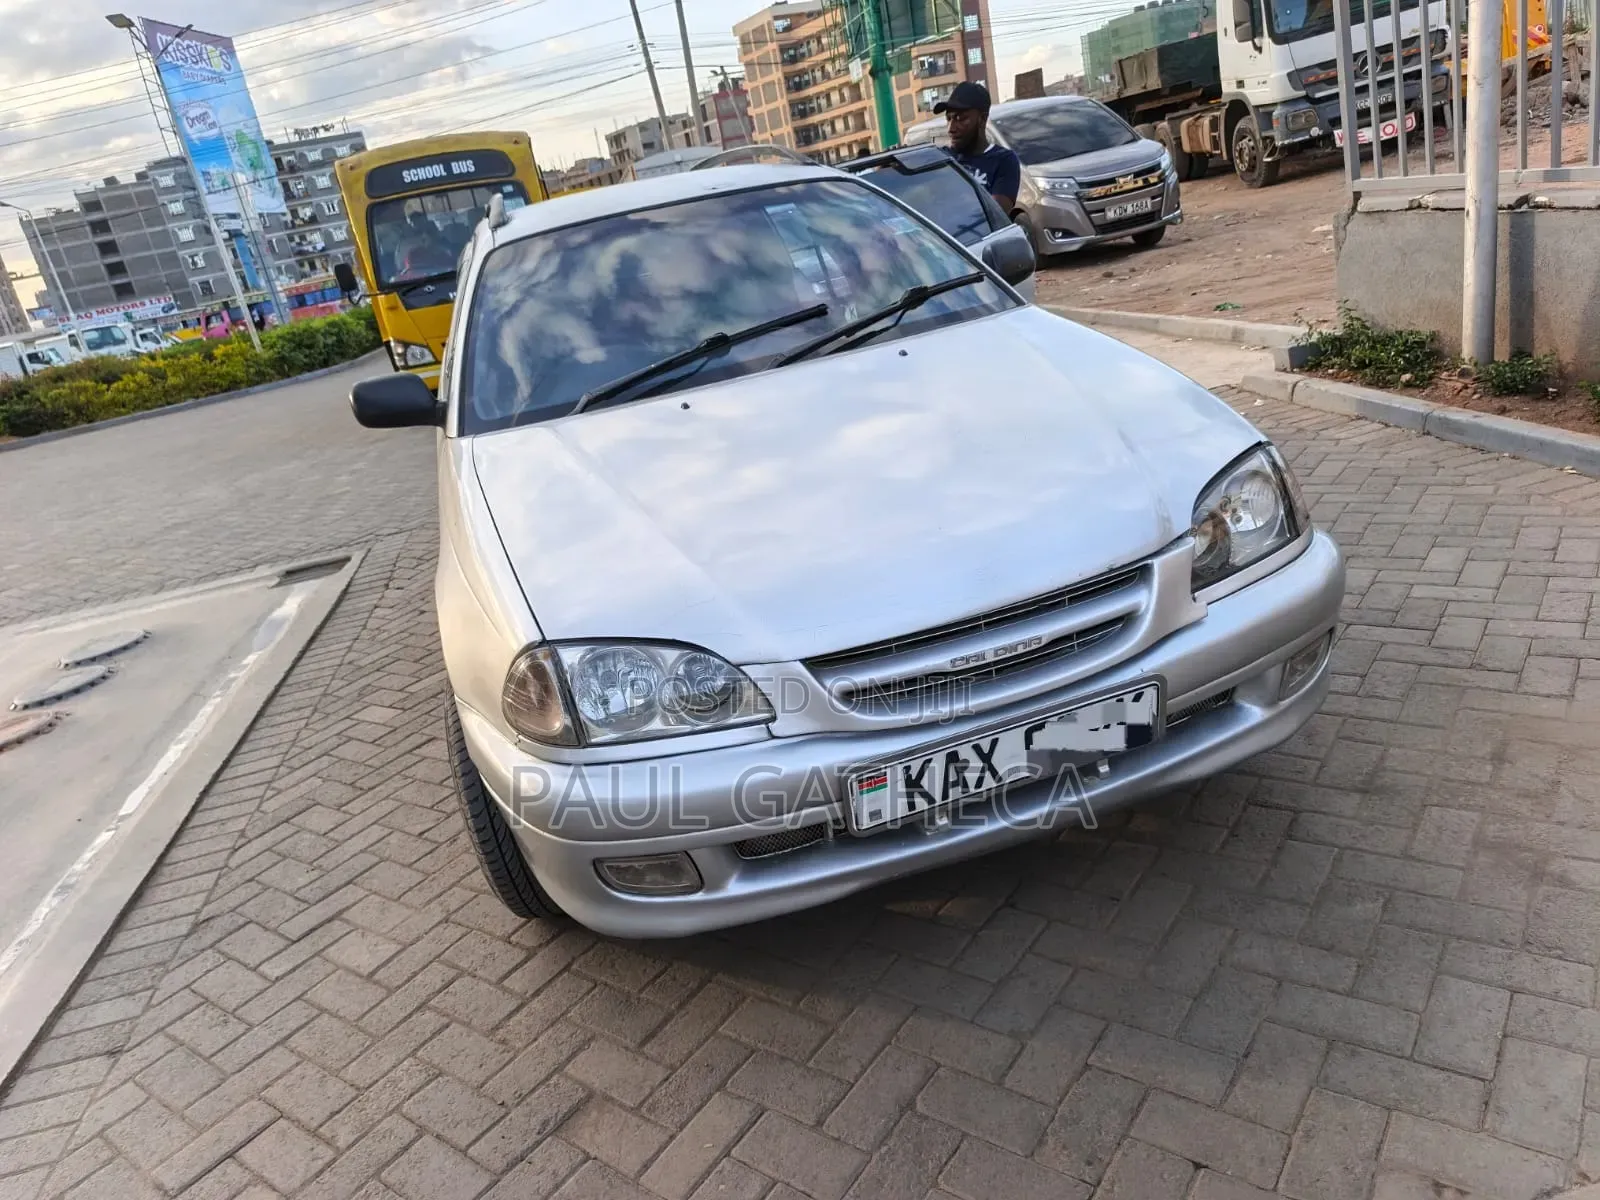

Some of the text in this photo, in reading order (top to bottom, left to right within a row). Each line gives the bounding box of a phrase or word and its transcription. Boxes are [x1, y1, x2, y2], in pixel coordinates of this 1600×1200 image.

[402, 160, 476, 183] SCHOOL BUS
[96, 302, 146, 316] MOTORS
[149, 296, 172, 306] LTD
[902, 737, 1002, 812] KAX
